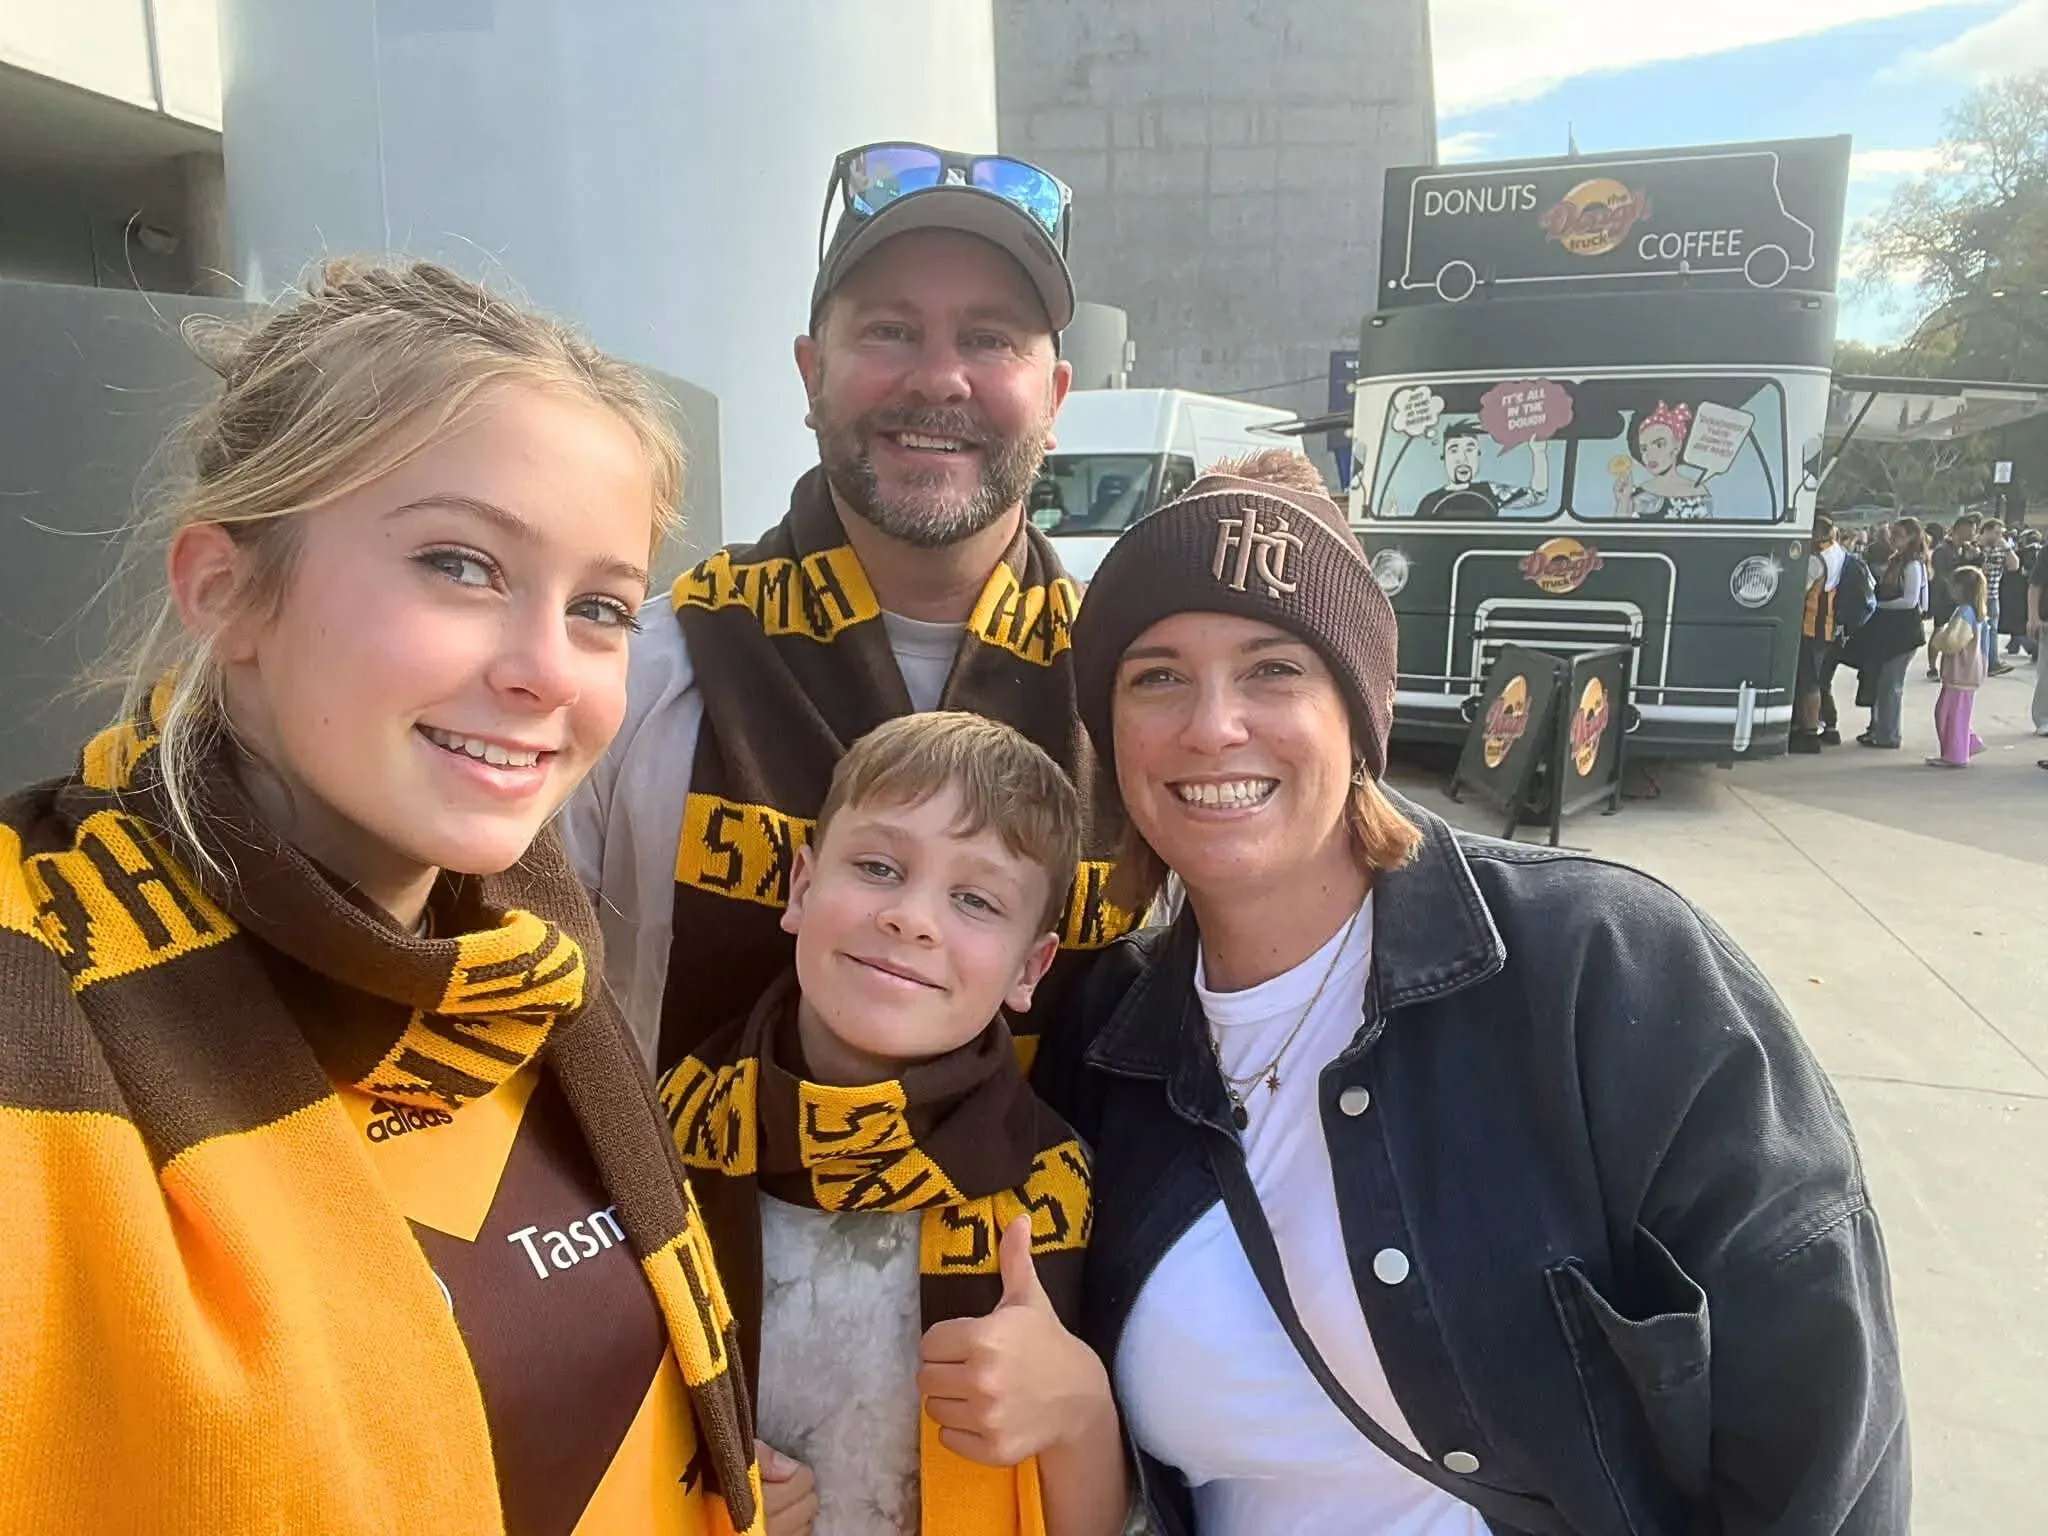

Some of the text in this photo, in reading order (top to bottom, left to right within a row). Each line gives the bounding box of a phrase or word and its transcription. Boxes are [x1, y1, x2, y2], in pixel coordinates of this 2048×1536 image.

[1424, 183, 1537, 217] DONUTS
[1638, 230, 1744, 261] COFFEE
[1527, 388, 1546, 401] ALL
[1508, 406, 1520, 418] IN
[366, 1105, 453, 1143] adidas
[506, 1204, 626, 1280] Tasm
